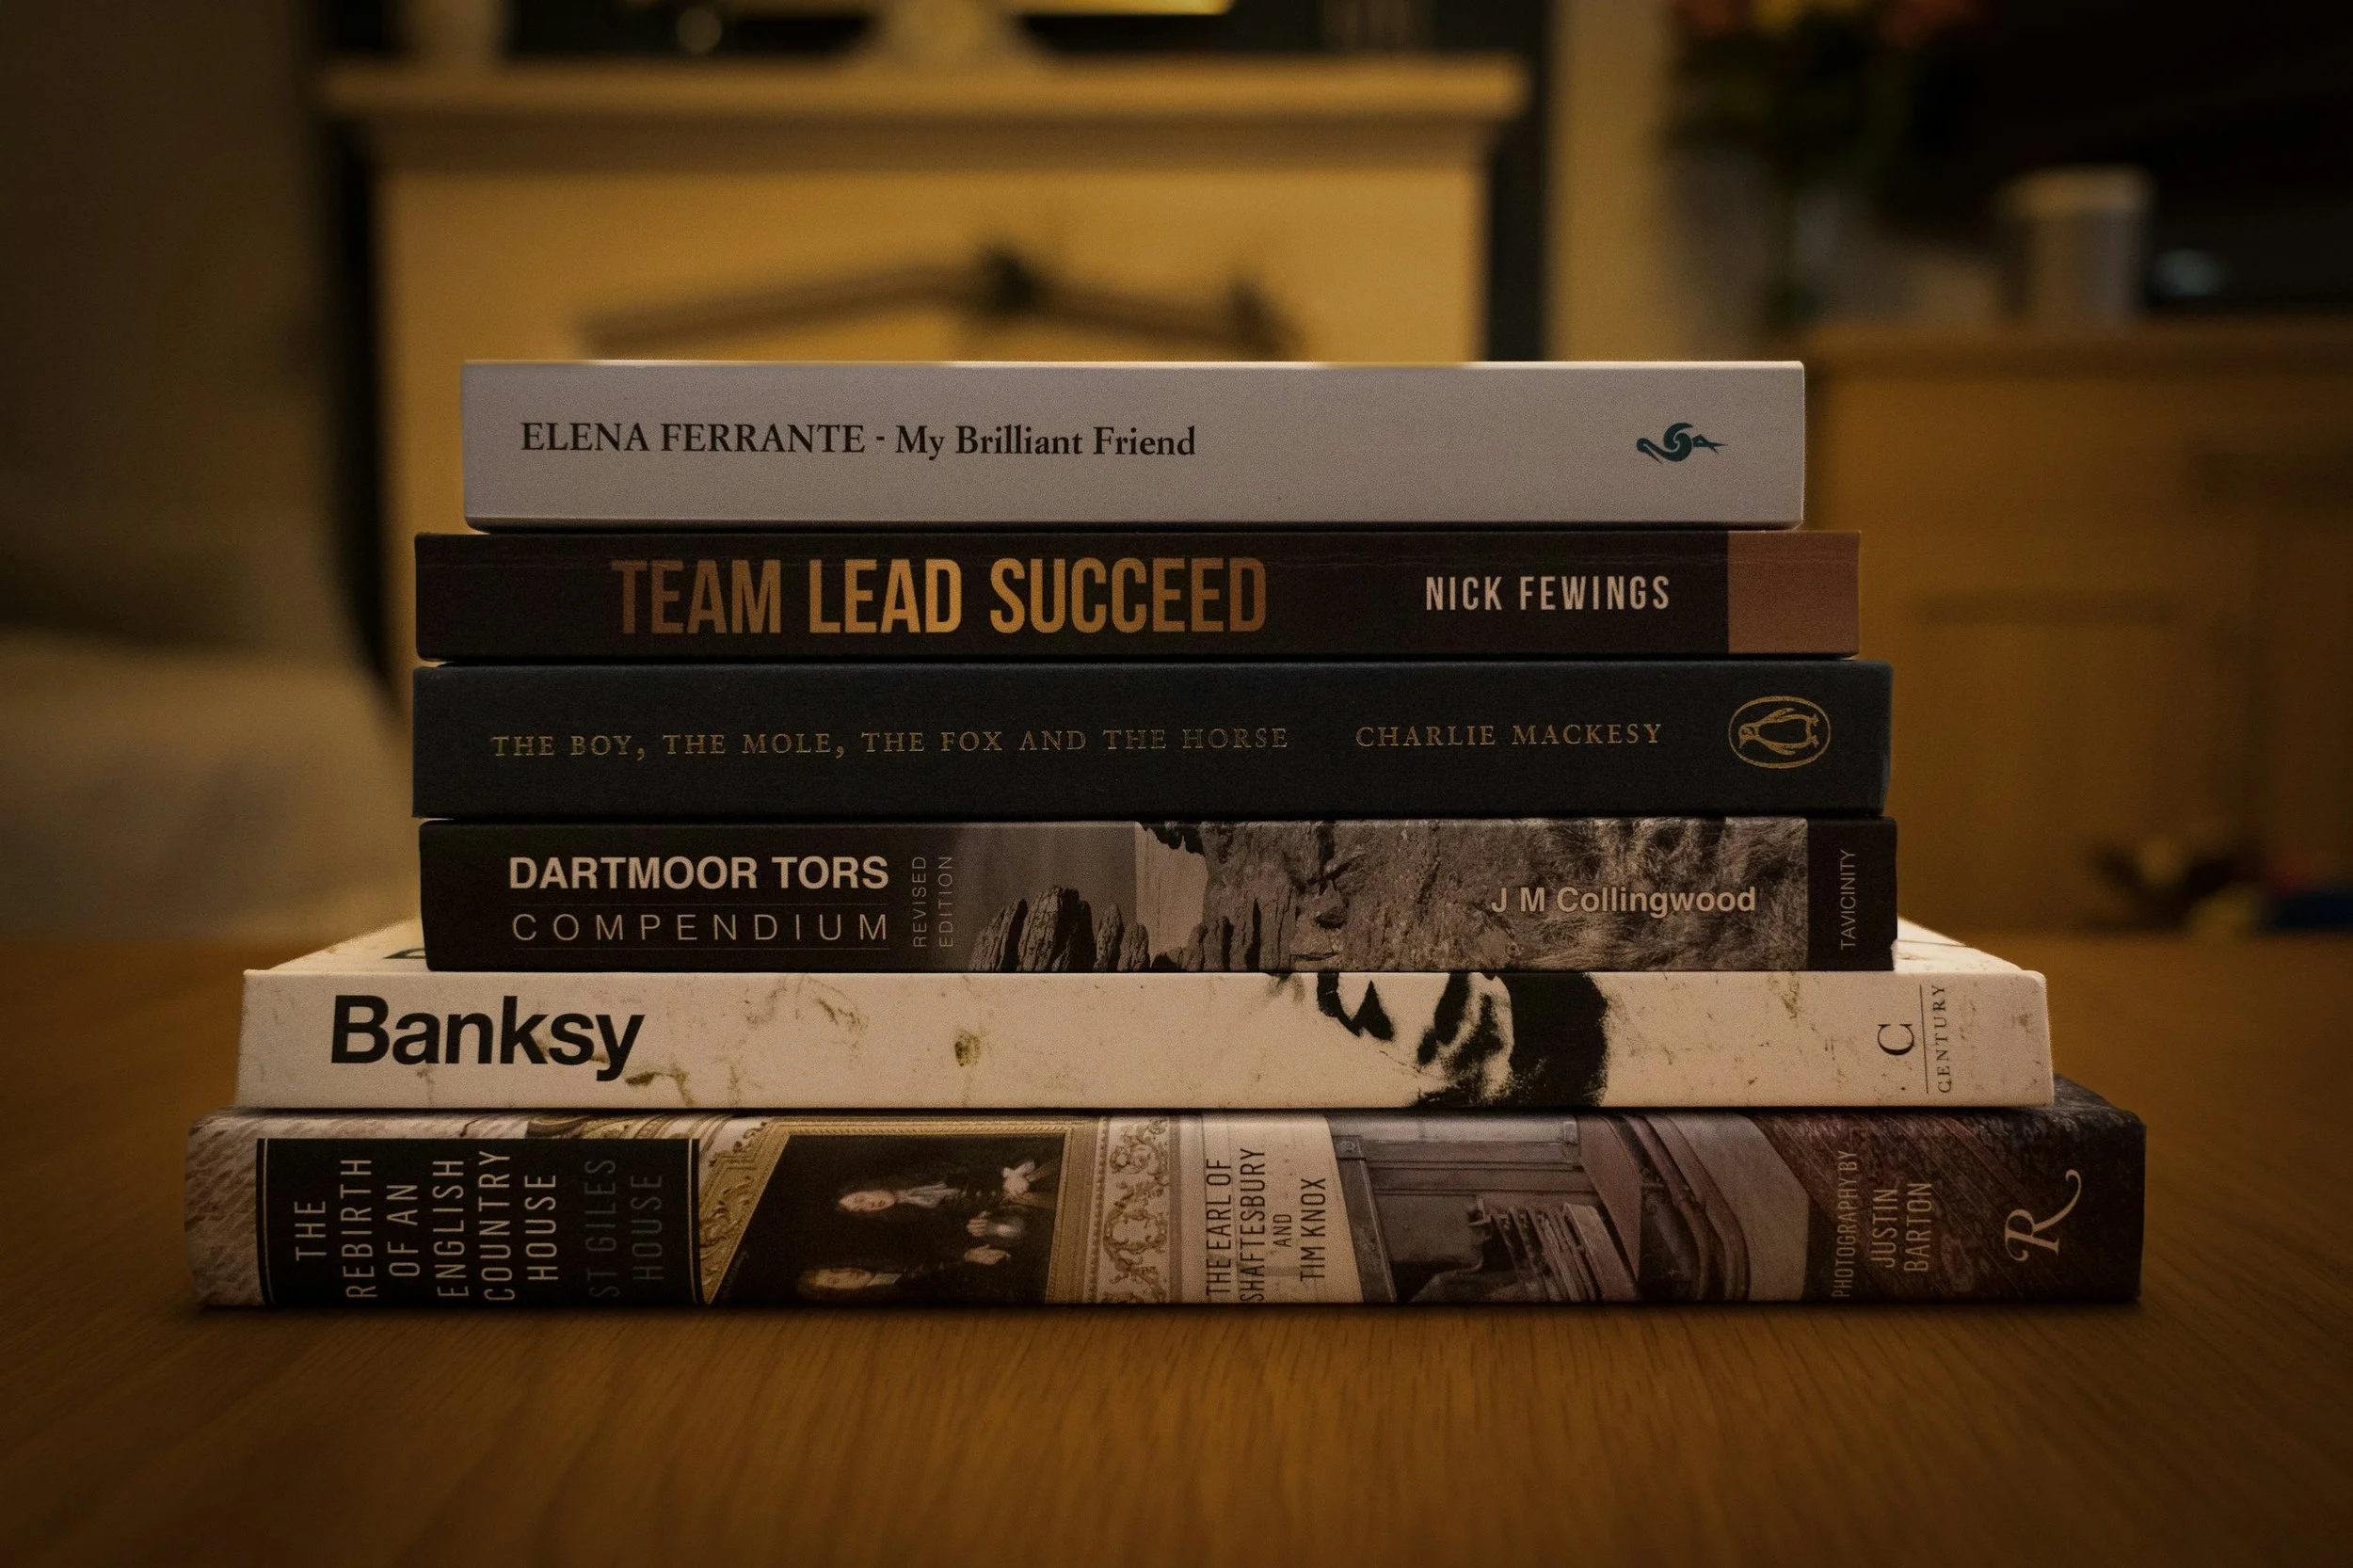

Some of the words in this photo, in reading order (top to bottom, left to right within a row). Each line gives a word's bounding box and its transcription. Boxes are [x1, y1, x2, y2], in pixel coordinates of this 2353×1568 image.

[520, 422, 649, 453] ELENA
[660, 424, 866, 454] FERRANTE
[895, 426, 944, 460] My
[955, 426, 1082, 456] Brilliant
[1093, 426, 1196, 456] Friend
[611, 559, 781, 634] TEAM
[808, 558, 962, 633] LEAD
[990, 557, 1267, 633] SUCCEED
[1425, 575, 1502, 611] NICK
[1519, 575, 1670, 611] FEWINGS
[490, 734, 553, 757] THE
[570, 734, 646, 761] BOY,
[663, 733, 724, 755] THE
[742, 732, 845, 759] MOLE,
[862, 731, 924, 753] THE
[941, 731, 1002, 751] FOX
[1018, 730, 1087, 751] AND
[1103, 729, 1165, 750] THE
[1182, 728, 1289, 749] HORSE
[1355, 725, 1496, 747] CHARLIE
[1512, 724, 1662, 746] MACKESY
[509, 856, 758, 889] DARTMOOR
[772, 856, 889, 889] TORS
[912, 856, 927, 948] REVISED
[939, 856, 953, 948] EDITION
[1839, 849, 1857, 951] TAVICINITY
[512, 913, 887, 941] COMPENDIUM
[1492, 887, 1509, 913] J
[1520, 887, 1545, 912] M
[1556, 887, 1755, 919] Collingwood
[331, 995, 645, 1081] Banksy
[1877, 1023, 1914, 1056] C
[1931, 984, 1952, 1094] CENTURY
[1206, 1159, 1231, 1186] OF
[1837, 1150, 1859, 1170] BY
[294, 1200, 327, 1261] THE
[340, 1159, 377, 1300] REBIRTH
[386, 1183, 418, 1226] AN
[432, 1160, 469, 1298] ENGLISH
[478, 1150, 516, 1303] COUNTRY
[524, 1174, 559, 1282] HOUSE
[584, 1159, 617, 1253] GILES
[631, 1175, 664, 1282] HOUSE
[1206, 1194, 1231, 1250] EARL
[1240, 1148, 1265, 1303] SHAFTESBURY
[1273, 1214, 1291, 1247] AND
[1301, 1178, 1325, 1237] KNOX
[1868, 1188, 1898, 1269] JUSTIN
[1904, 1182, 1932, 1272] BARTON
[2005, 1169, 2082, 1263] R
[387, 1242, 421, 1278] OF
[1301, 1246, 1325, 1281] TIM
[1832, 1172, 1859, 1299] PHOTOGRAPHY
[586, 1268, 621, 1300] ST
[1206, 1258, 1231, 1295] THE
